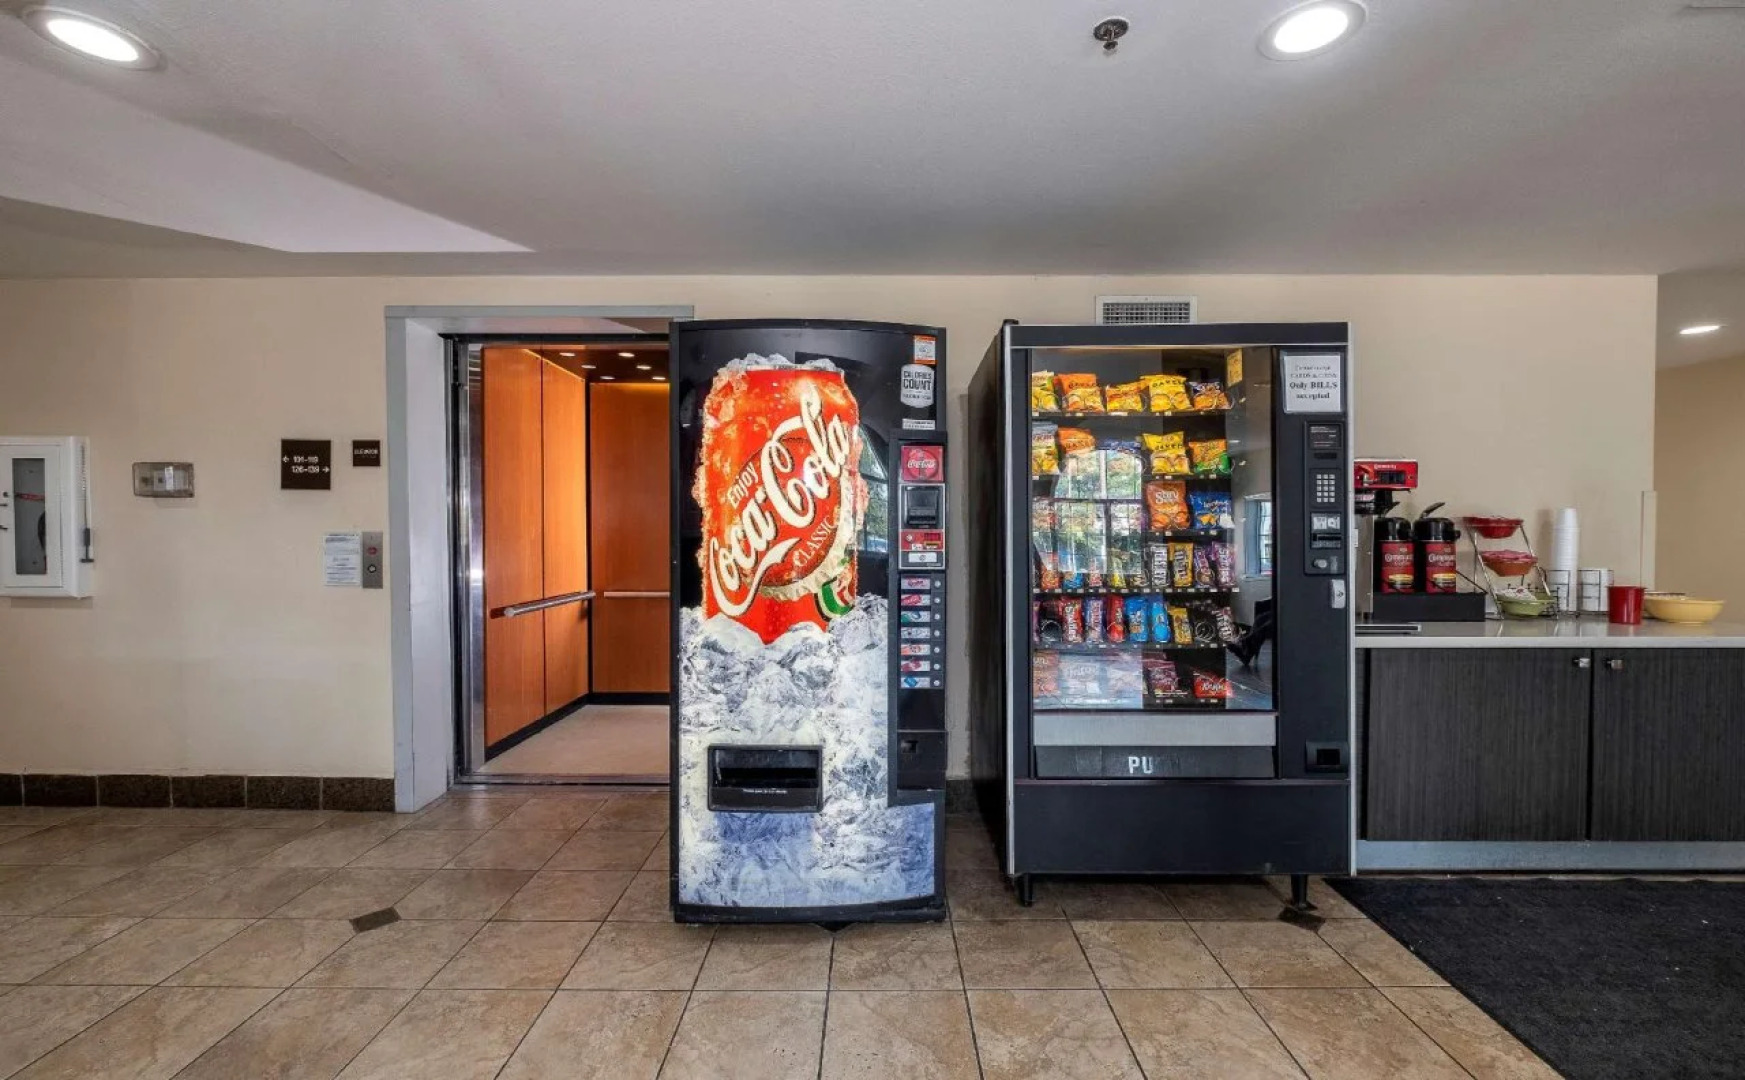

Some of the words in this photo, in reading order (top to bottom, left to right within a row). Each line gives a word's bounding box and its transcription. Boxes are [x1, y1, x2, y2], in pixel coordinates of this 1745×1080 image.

[903, 379, 932, 391] COUNT
[1289, 381, 1308, 390] Only
[1310, 381, 1338, 390] BILLS
[1296, 392, 1330, 400] accepted
[708, 380, 850, 617] Coca-Cola
[727, 461, 759, 508] Enjoy
[792, 514, 839, 568] CLASSIC
